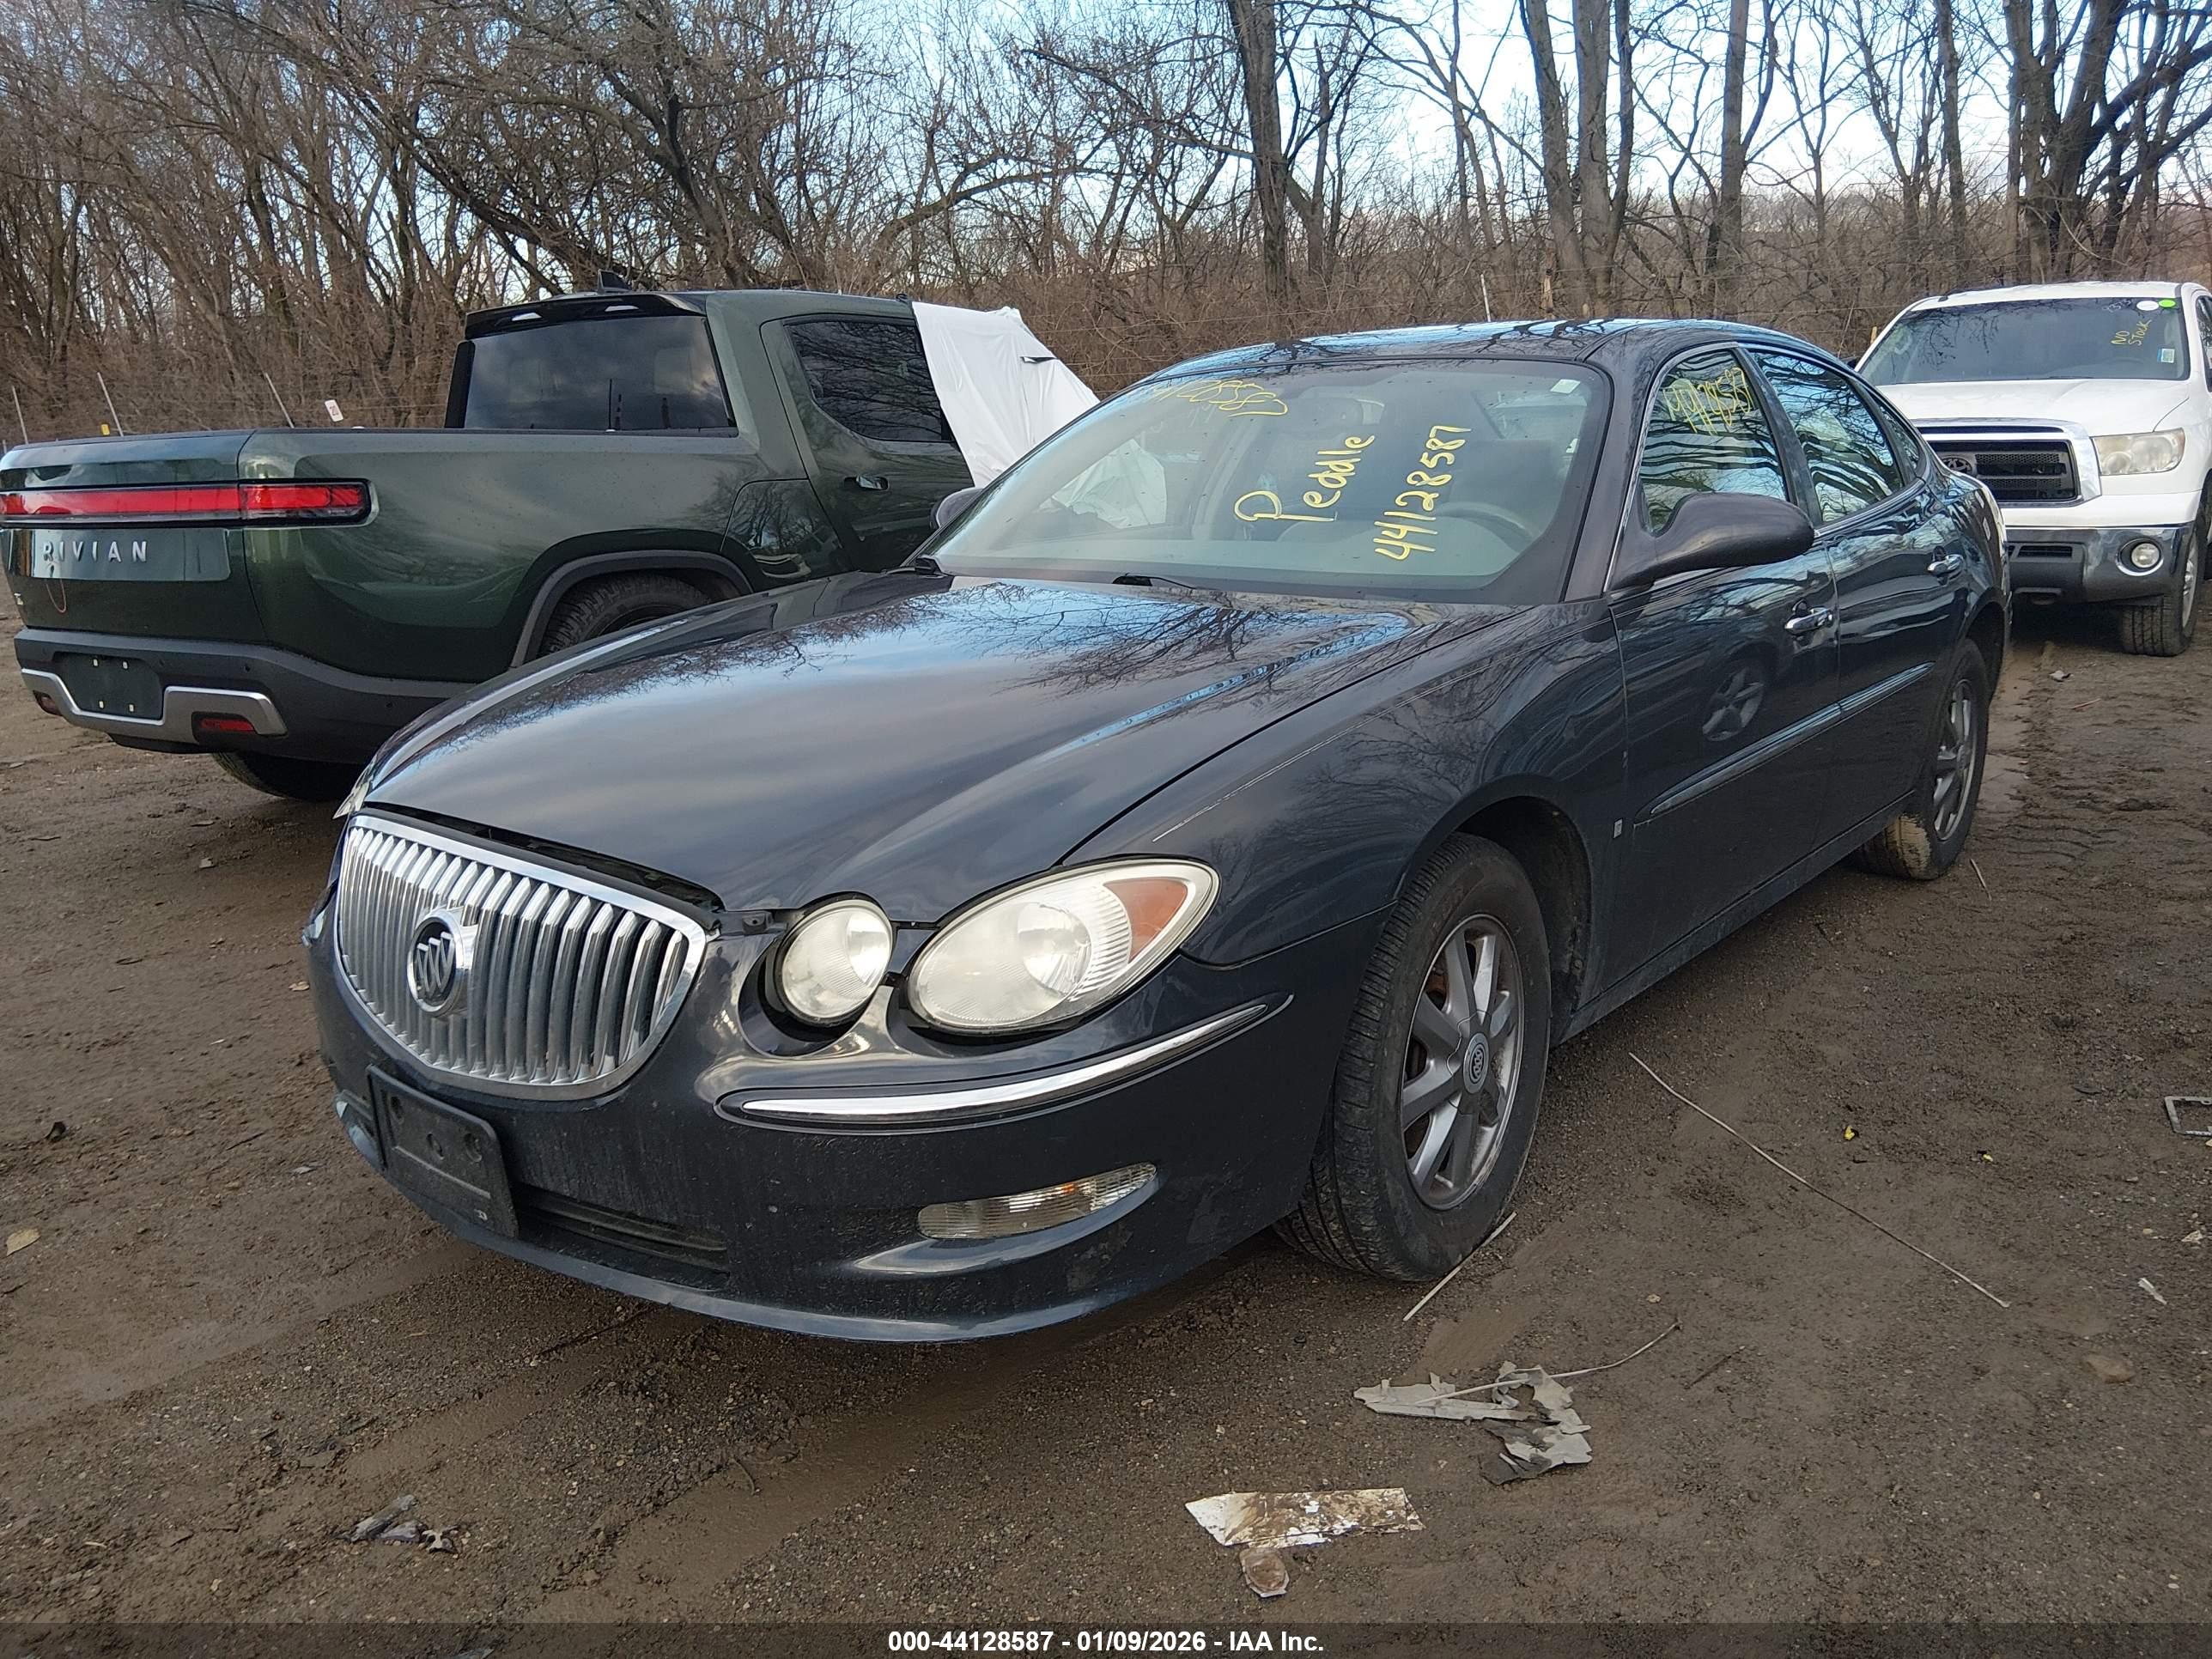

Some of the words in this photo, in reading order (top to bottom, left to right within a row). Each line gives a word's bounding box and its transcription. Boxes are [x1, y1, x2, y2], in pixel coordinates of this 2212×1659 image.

[1234, 434, 1375, 522] Peddle
[1373, 425, 1472, 561] 44128587
[43, 540, 147, 562] RIVIAN
